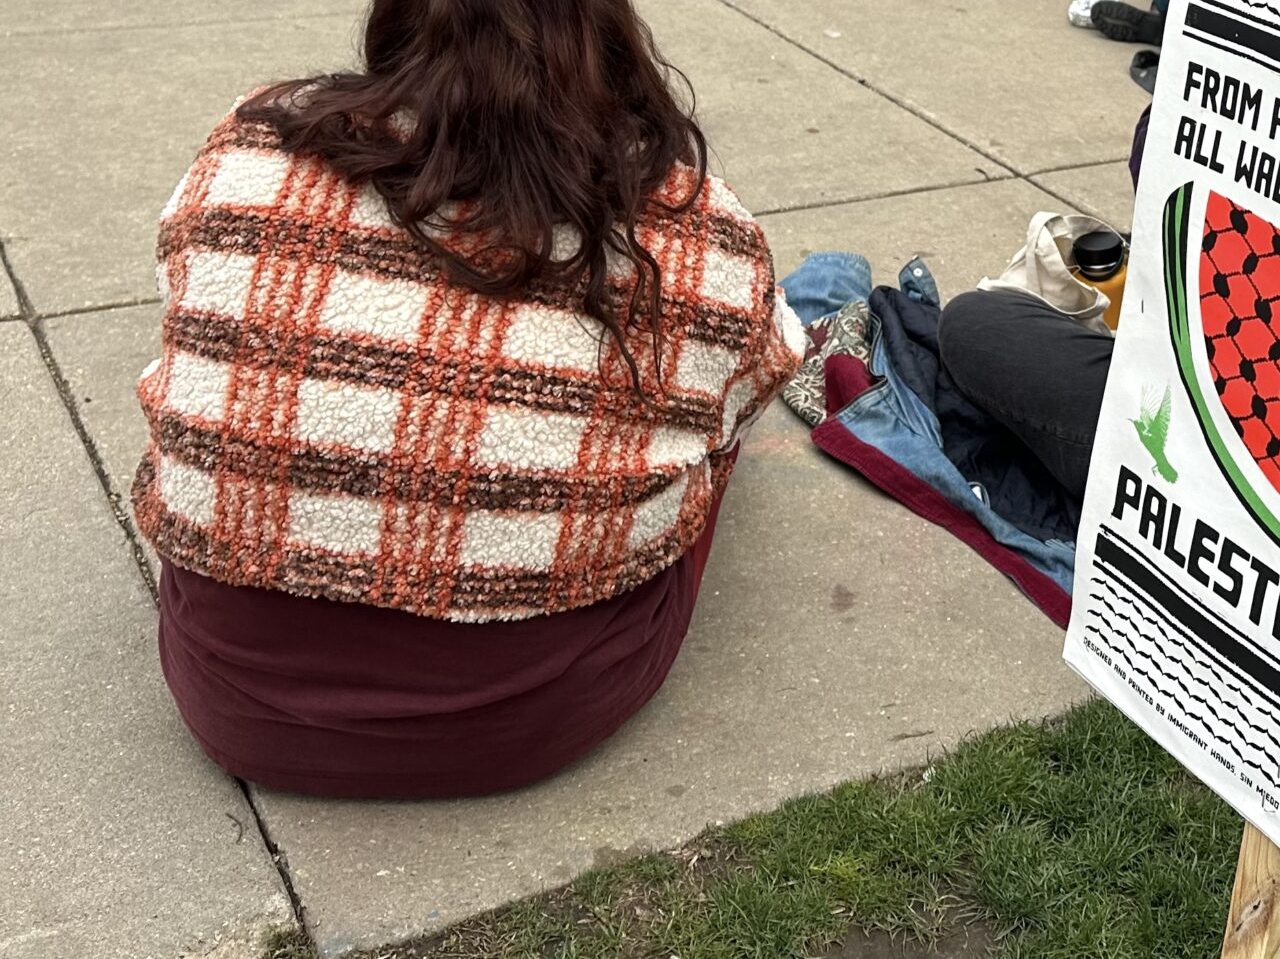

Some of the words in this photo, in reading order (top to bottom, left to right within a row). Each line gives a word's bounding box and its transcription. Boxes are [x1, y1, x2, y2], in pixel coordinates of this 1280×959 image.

[1183, 61, 1263, 131] FROM
[1174, 116, 1225, 174] ALL
[1083, 636, 1113, 666] DESIGNED
[1113, 664, 1127, 681] AND
[1128, 678, 1154, 706] PRINTED
[1155, 703, 1166, 716] BY
[1167, 713, 1209, 751] IMMIGRANT
[1240, 773, 1253, 788] SIN
[1256, 785, 1280, 810] MIEDO
